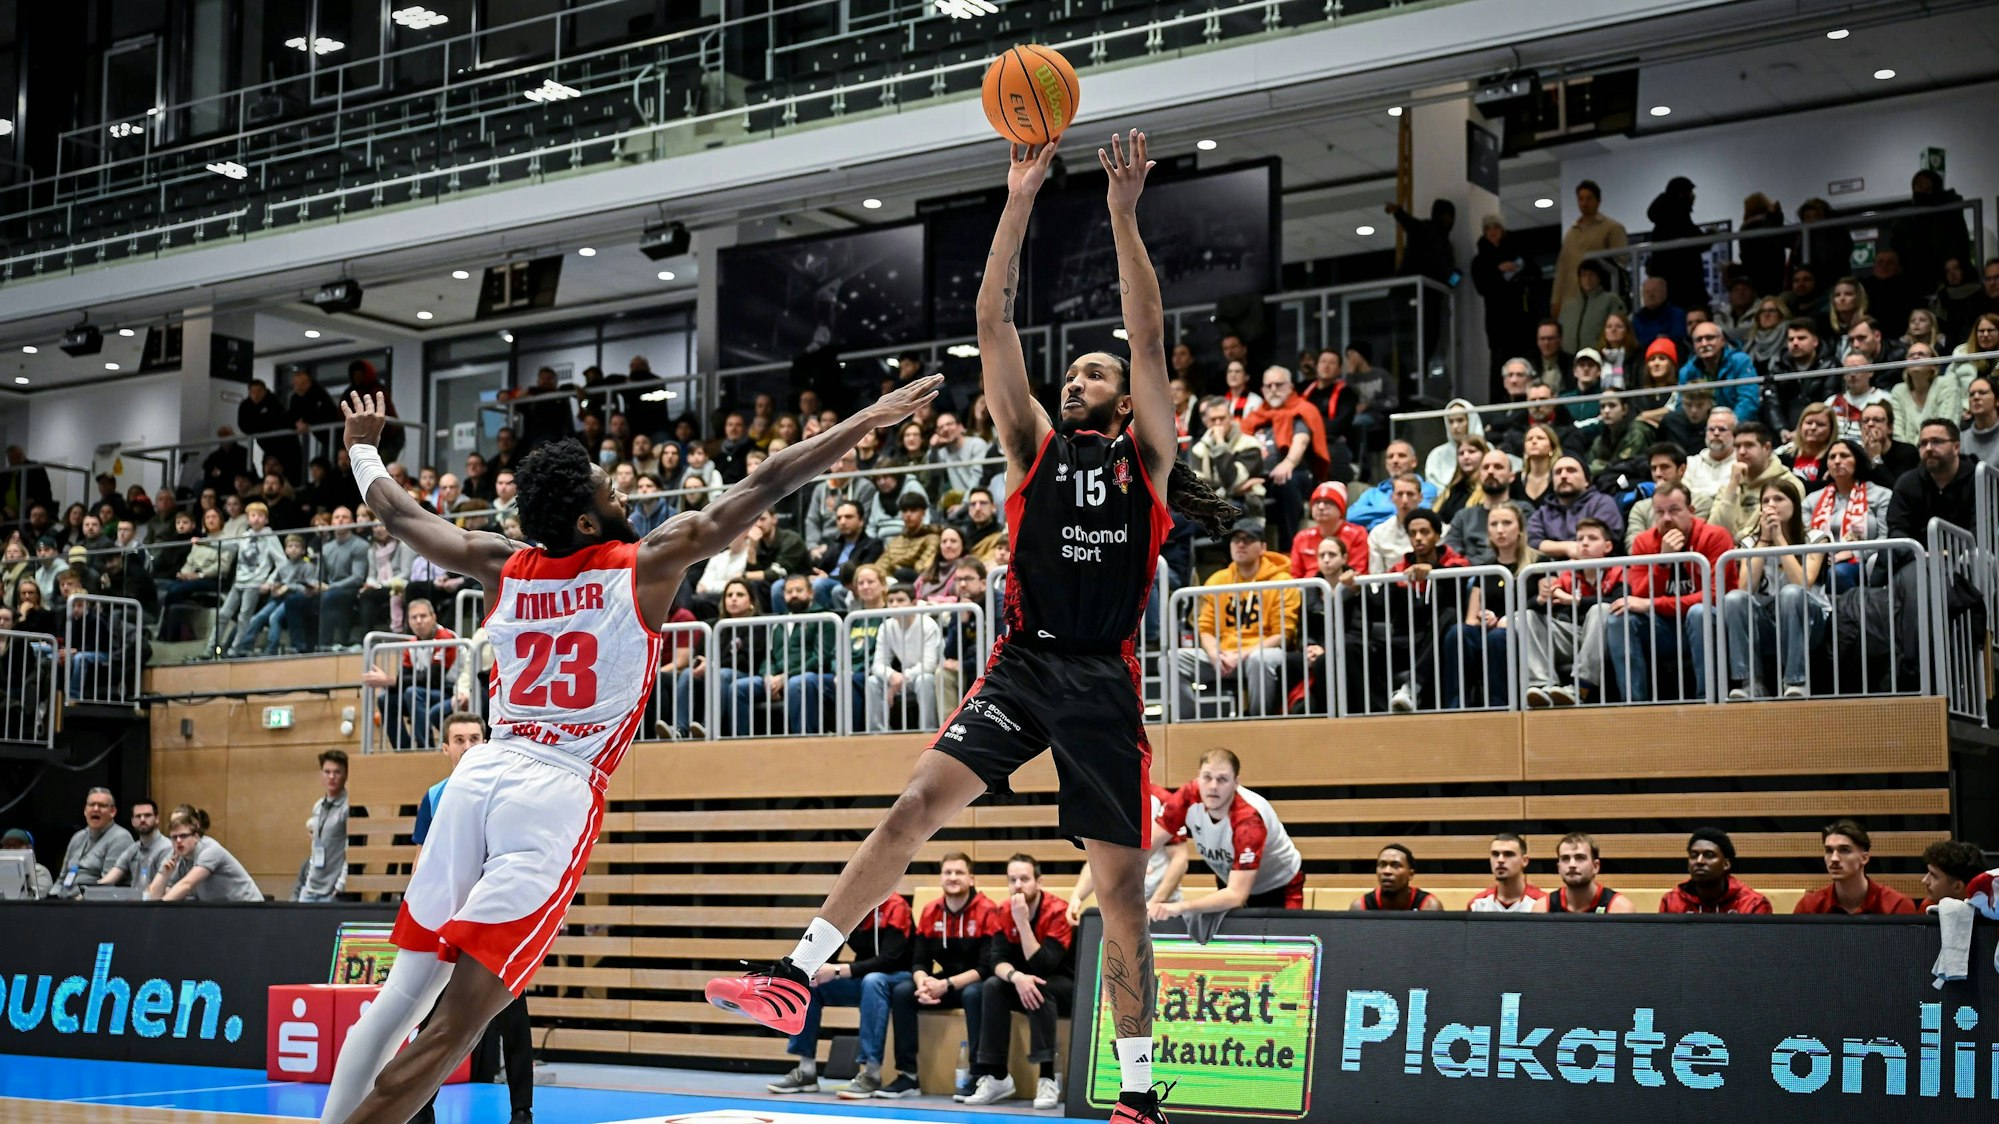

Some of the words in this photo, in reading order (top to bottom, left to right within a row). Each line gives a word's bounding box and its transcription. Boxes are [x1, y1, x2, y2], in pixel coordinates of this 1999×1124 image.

[1035, 64, 1063, 131] Wilson
[1073, 466, 1106, 507] 15
[515, 583, 604, 620] MILLER
[509, 631, 598, 710] 23
[984, 710, 1012, 732] Gothaer
[988, 703, 1021, 732] Barmenia
[346, 957, 391, 984] Pla
[0, 942, 244, 1044] uchen.
[1152, 971, 1297, 1024] akat-
[1109, 1033, 1295, 1069] rkauft.de
[1340, 988, 1729, 1089] Plakate
[1771, 1001, 1999, 1100] onli
